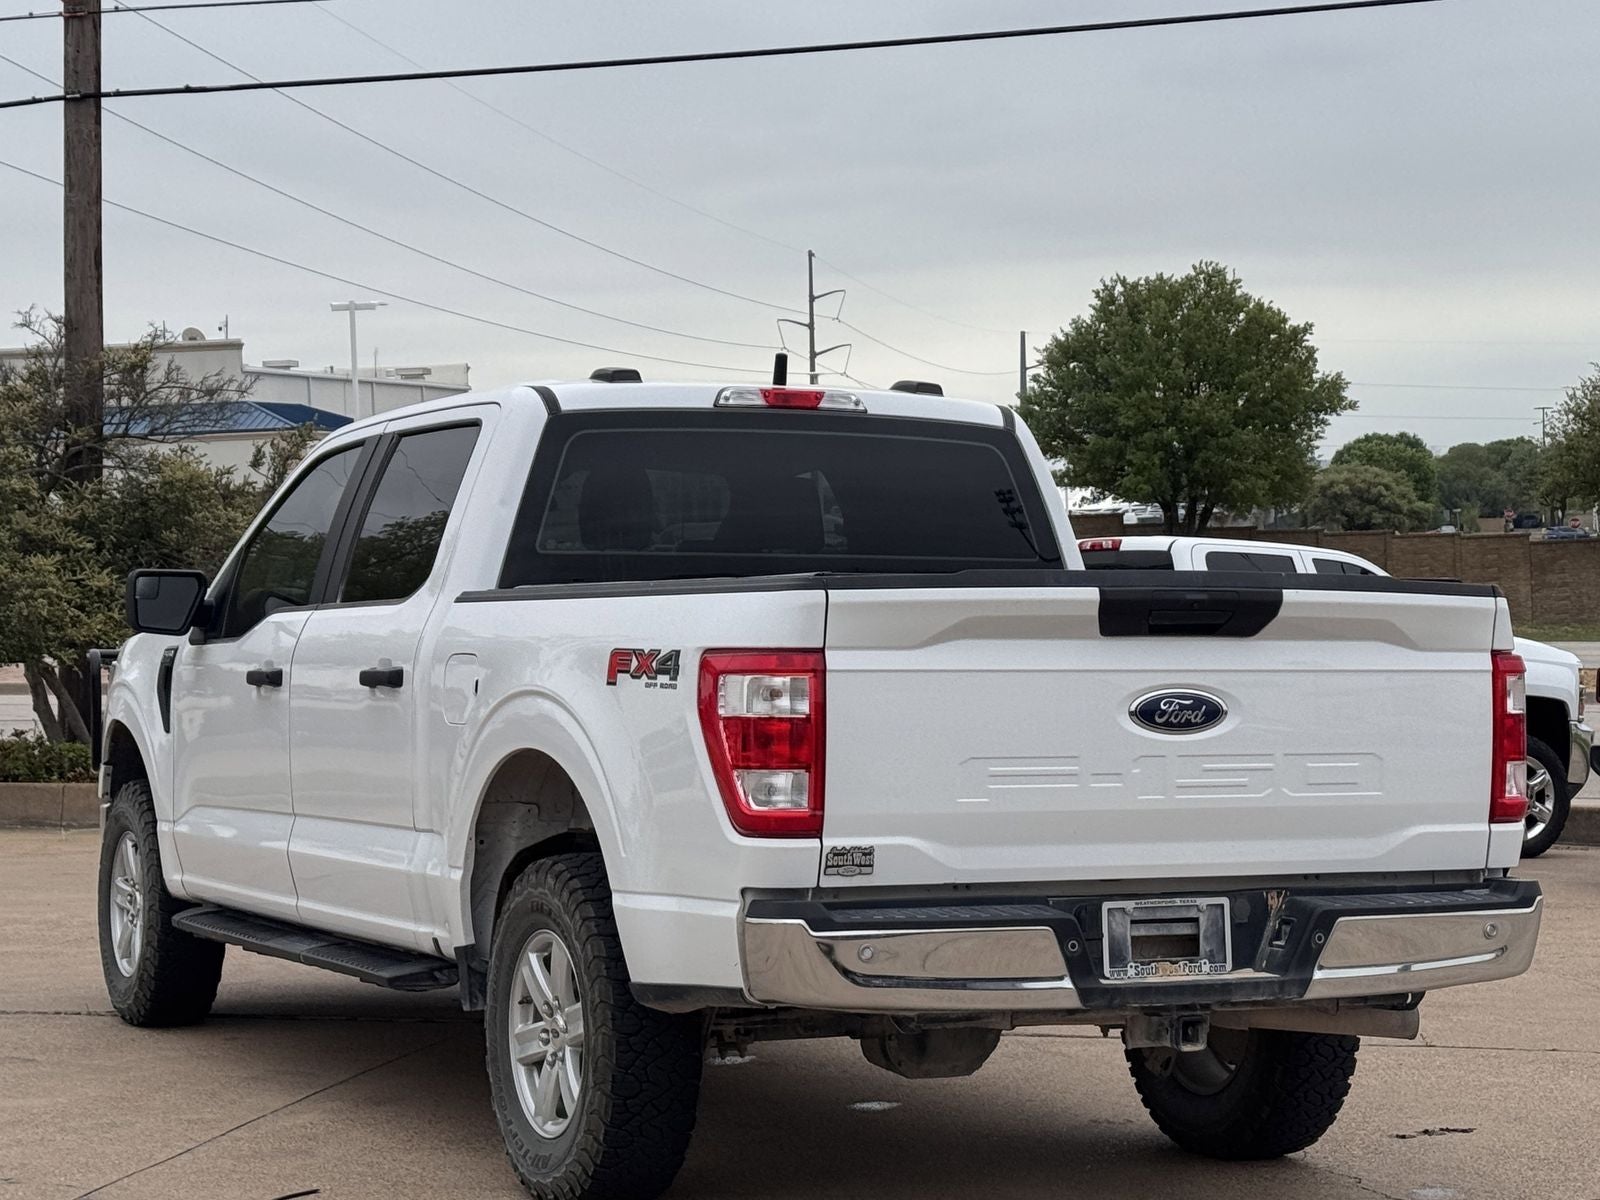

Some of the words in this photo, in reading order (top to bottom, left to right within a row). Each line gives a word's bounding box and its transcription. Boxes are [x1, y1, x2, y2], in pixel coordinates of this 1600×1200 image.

[606, 648, 681, 686] FX4
[1154, 698, 1207, 723] Ford
[956, 752, 1384, 802] F-150
